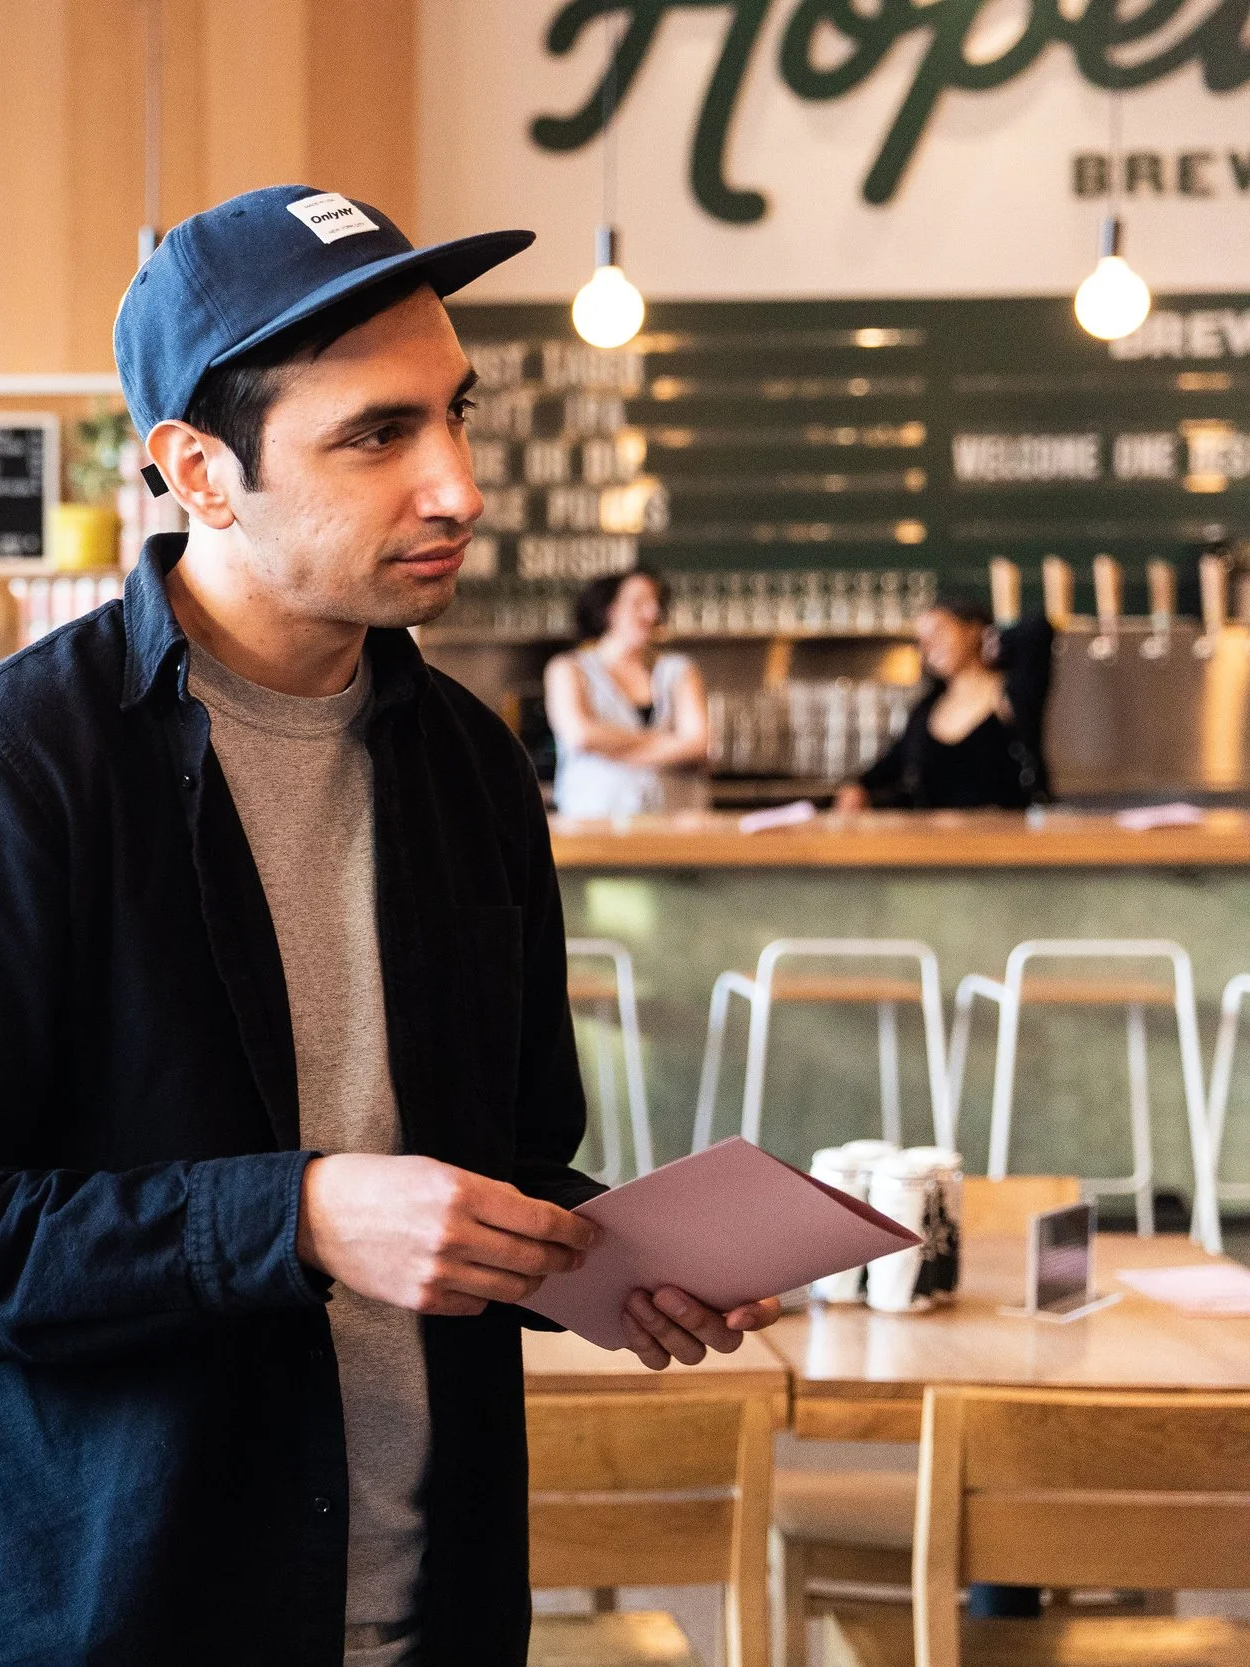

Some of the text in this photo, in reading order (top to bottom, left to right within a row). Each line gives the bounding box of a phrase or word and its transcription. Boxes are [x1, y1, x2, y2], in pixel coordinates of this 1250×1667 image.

[529, 0, 1250, 225] Hope
[310, 207, 354, 224] OnlyNY
[951, 431, 1100, 482] WELCOME
[1111, 431, 1177, 481] ONE
